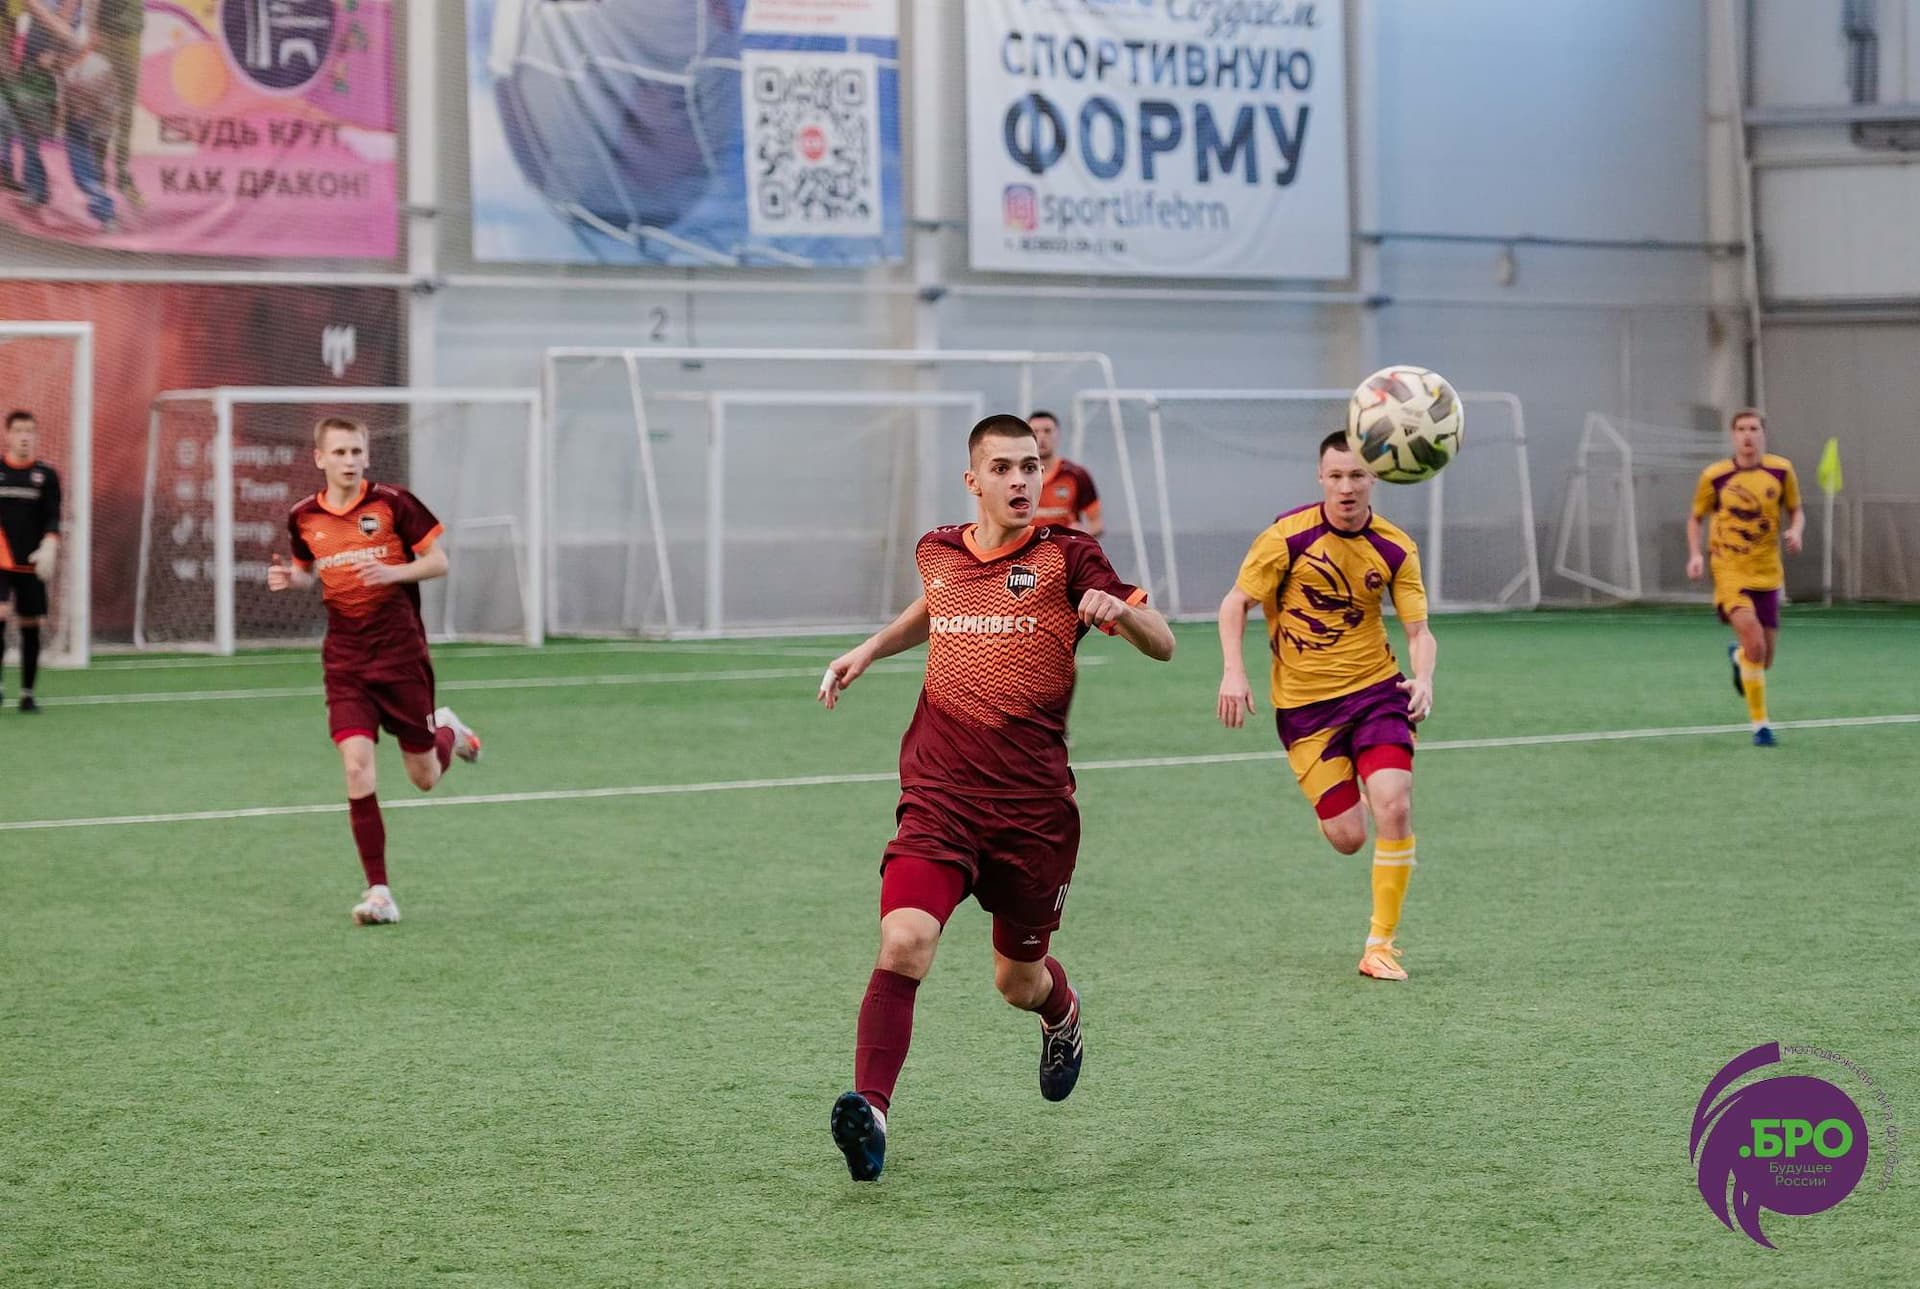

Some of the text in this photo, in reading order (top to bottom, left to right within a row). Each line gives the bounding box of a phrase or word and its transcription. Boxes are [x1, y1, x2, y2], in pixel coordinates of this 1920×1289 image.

[1003, 31, 1313, 91] СПОРТИВНУЮ
[158, 115, 259, 149] БУДЬ
[1004, 93, 1310, 187] ФОРМУ
[160, 167, 223, 194] КАК
[650, 308, 668, 341] 2
[1009, 573, 1035, 588] ТЕМП
